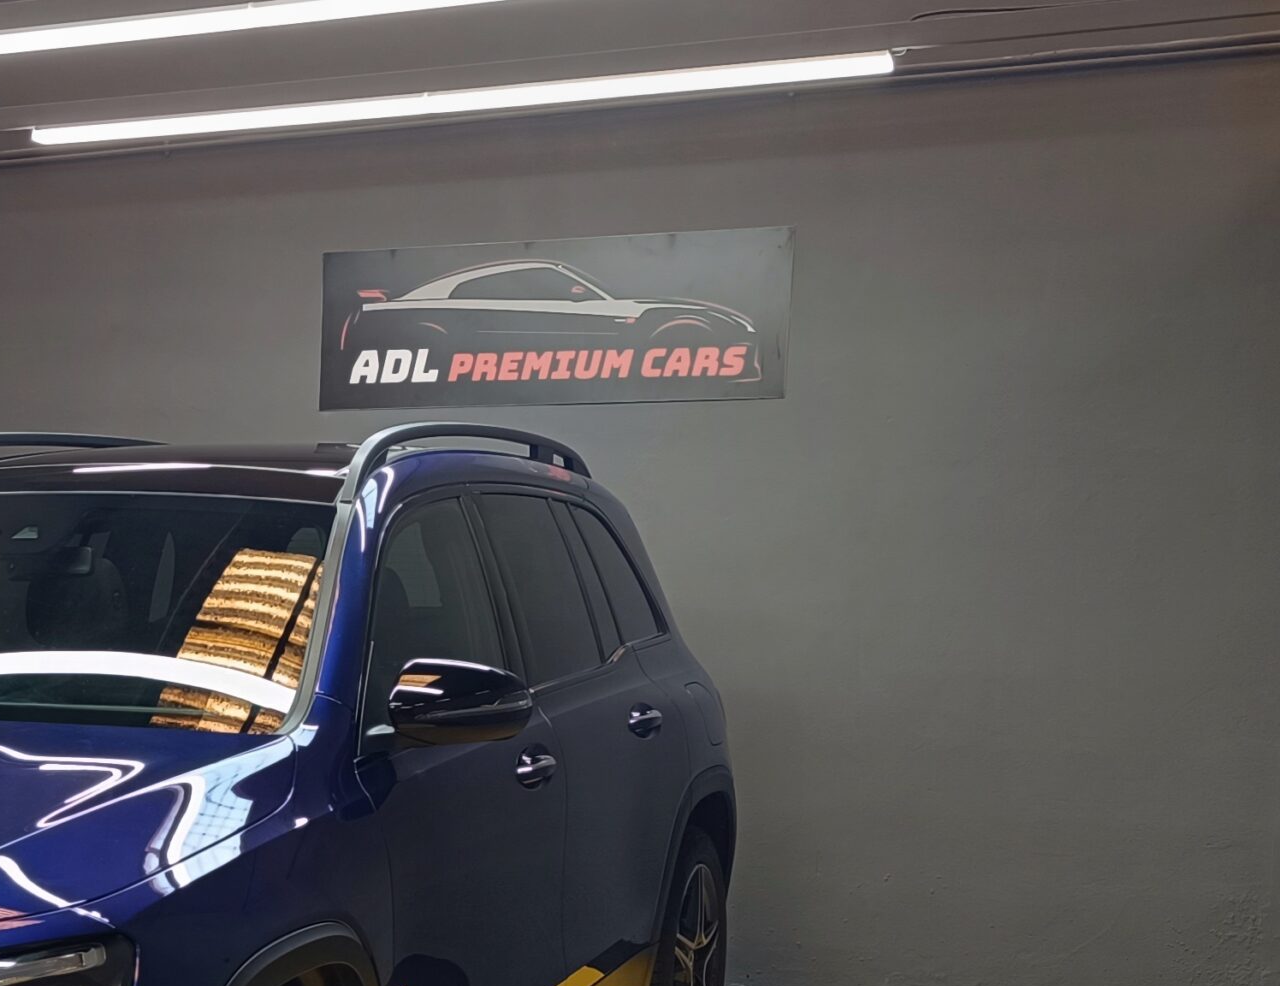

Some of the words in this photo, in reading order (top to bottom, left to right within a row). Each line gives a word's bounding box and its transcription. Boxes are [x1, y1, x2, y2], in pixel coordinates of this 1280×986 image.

[349, 348, 439, 384] ADL
[447, 349, 634, 382] PREMIUM
[640, 346, 747, 377] CARS
